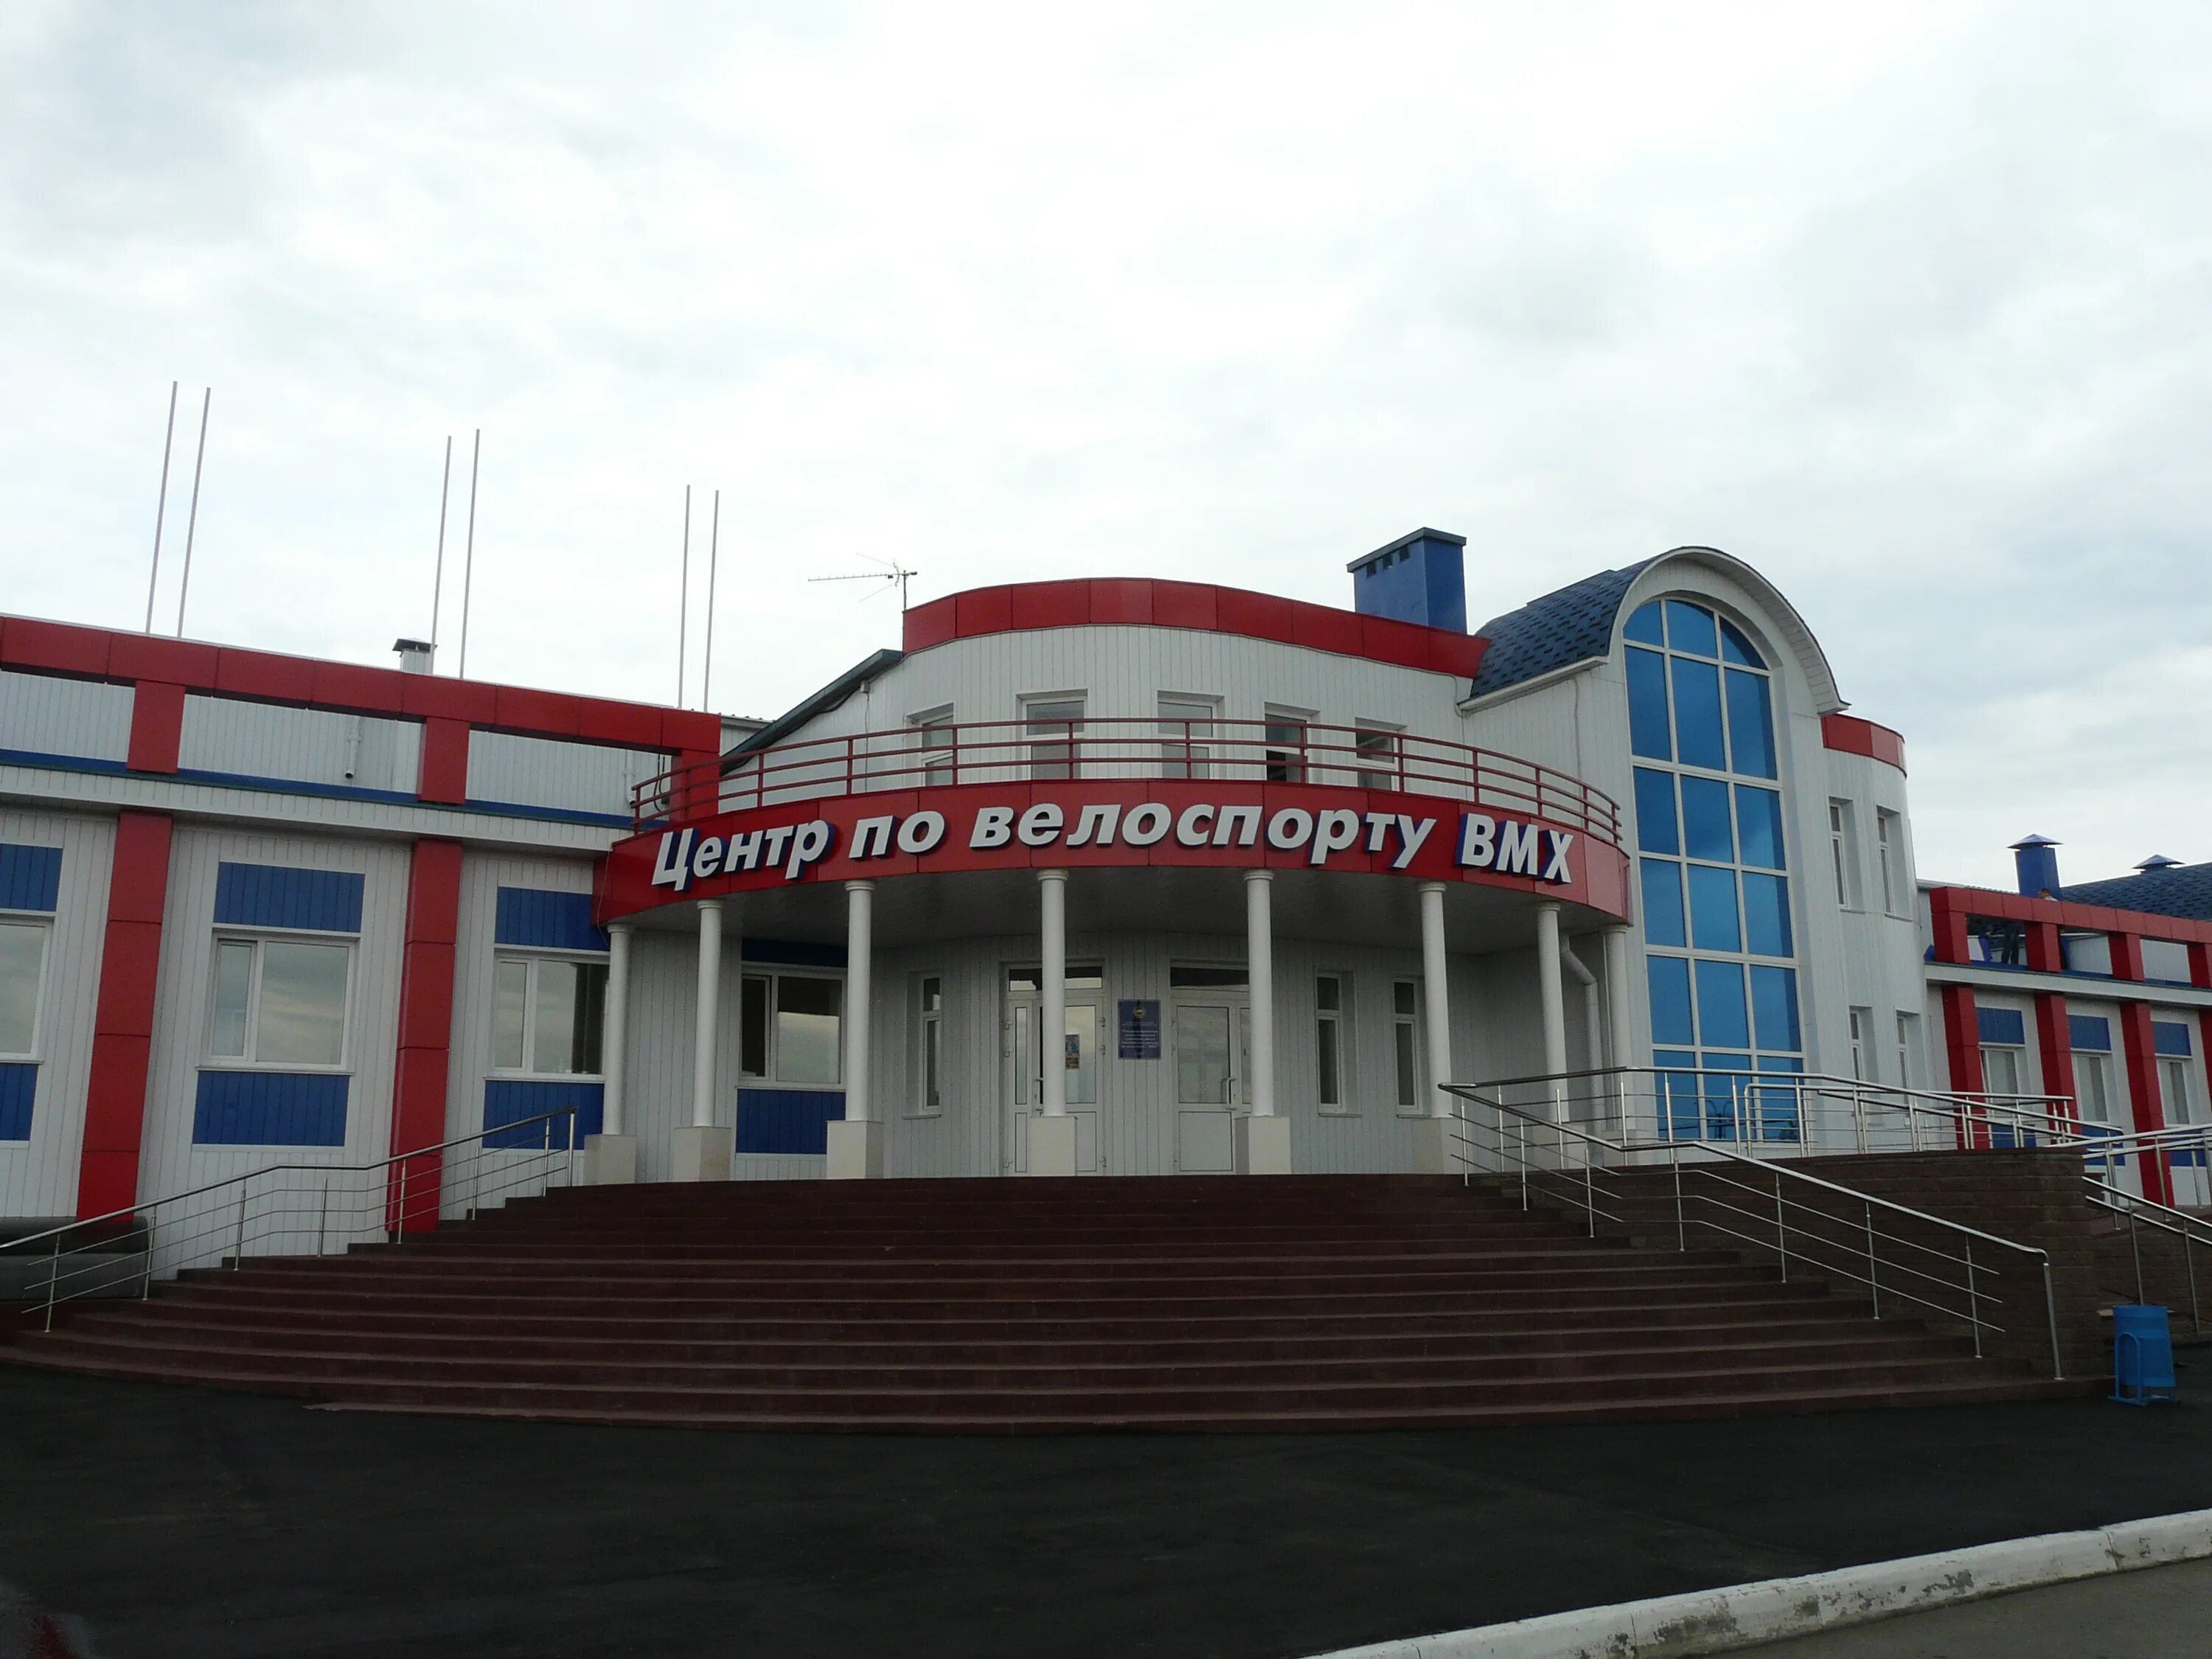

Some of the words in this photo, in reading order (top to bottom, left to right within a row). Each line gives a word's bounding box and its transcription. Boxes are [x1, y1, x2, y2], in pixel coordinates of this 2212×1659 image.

[652, 819, 832, 891] Центр
[849, 810, 945, 859] по
[970, 802, 1437, 869] велоспорту
